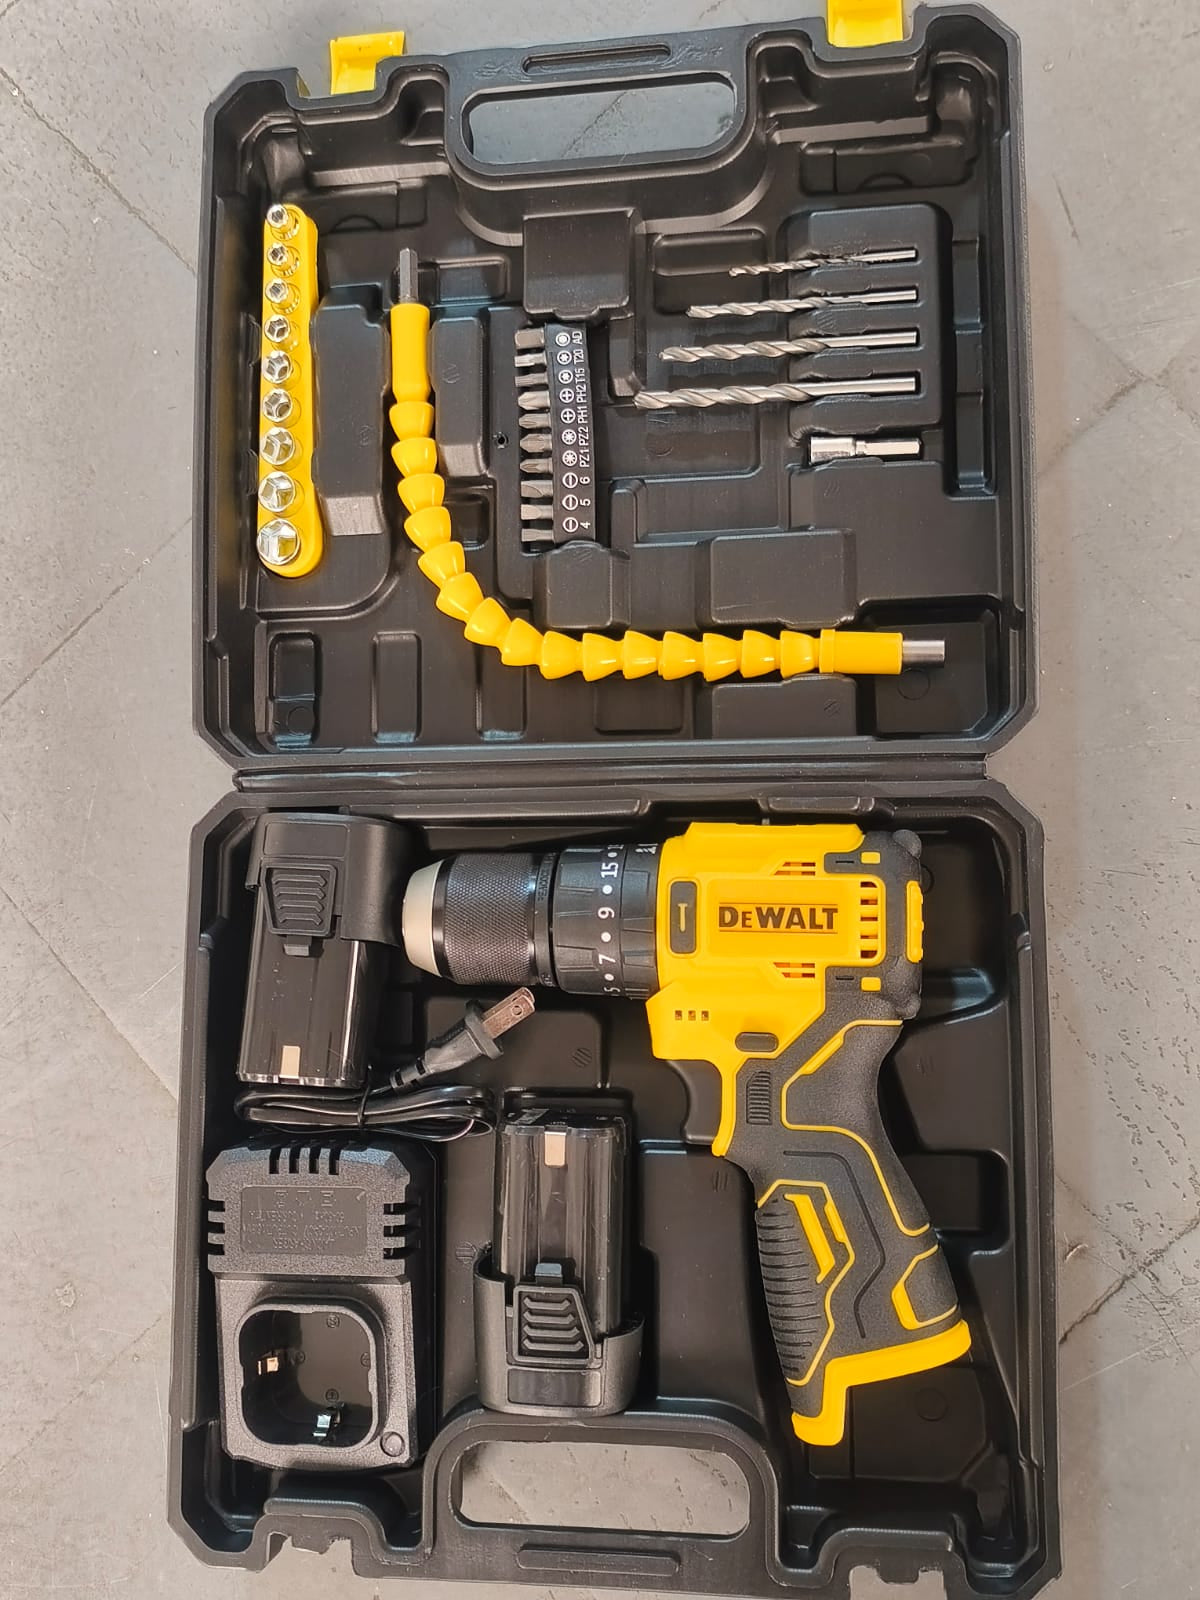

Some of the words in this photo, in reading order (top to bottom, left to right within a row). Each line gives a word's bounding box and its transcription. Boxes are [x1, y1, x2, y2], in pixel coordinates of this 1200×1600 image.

[572, 331, 583, 345] AD
[573, 349, 584, 365] T20
[575, 384, 587, 403] PH2
[576, 405, 588, 424] PH1
[578, 426, 589, 446] PZ2
[579, 449, 590, 468] PZ1
[579, 476, 591, 485] 6
[580, 498, 591, 506] 5
[580, 521, 591, 529] 4
[600, 862, 619, 879] 15
[597, 906, 615, 919] 9
[598, 953, 616, 965] 7
